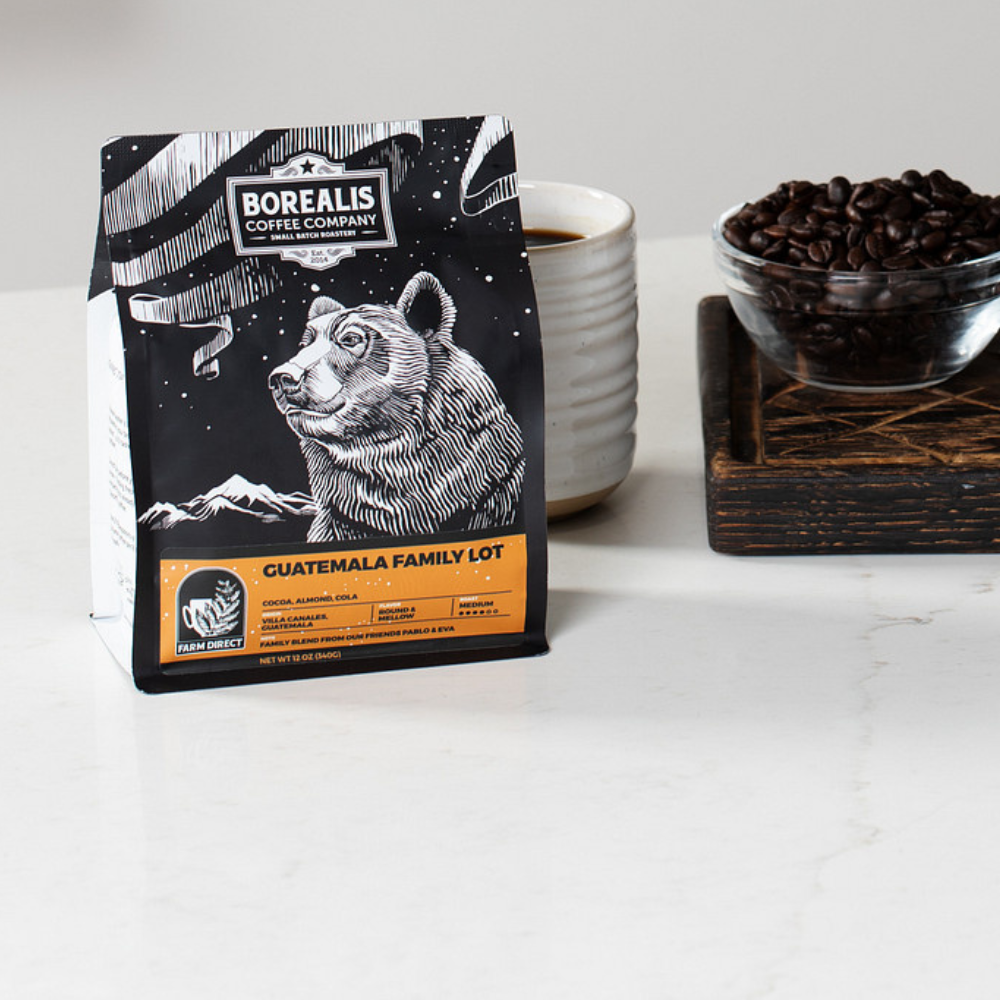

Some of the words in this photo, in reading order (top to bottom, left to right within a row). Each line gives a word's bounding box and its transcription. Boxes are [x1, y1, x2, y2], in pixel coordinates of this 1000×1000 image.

[242, 186, 375, 216] BOREALIS
[245, 218, 300, 232] COFFEE
[304, 214, 376, 229] COMPANY
[270, 233, 294, 241] SMALL
[296, 232, 319, 240] BATCH
[321, 230, 356, 238] ROASTERY
[263, 556, 388, 578] GUATEMALA
[393, 550, 464, 568] FAMILY
[468, 544, 504, 562] LOT
[262, 599, 294, 607] COCOA,
[296, 595, 333, 604] ALMOND,
[378, 613, 414, 621] MELLOW
[379, 607, 409, 615] ROUND
[287, 614, 328, 622] CANALES,
[262, 622, 313, 631] GUATEMALA
[260, 639, 290, 648] FAMILY
[291, 637, 319, 645] BLEND
[365, 630, 401, 639] FRIENDS
[402, 627, 429, 635] PABLO
[177, 642, 205, 653] FARM
[207, 638, 243, 649] DIRECT
[260, 657, 276, 665] NET
[277, 655, 292, 663] WT
[301, 653, 315, 661] OZ
[315, 651, 341, 660] (340G)
